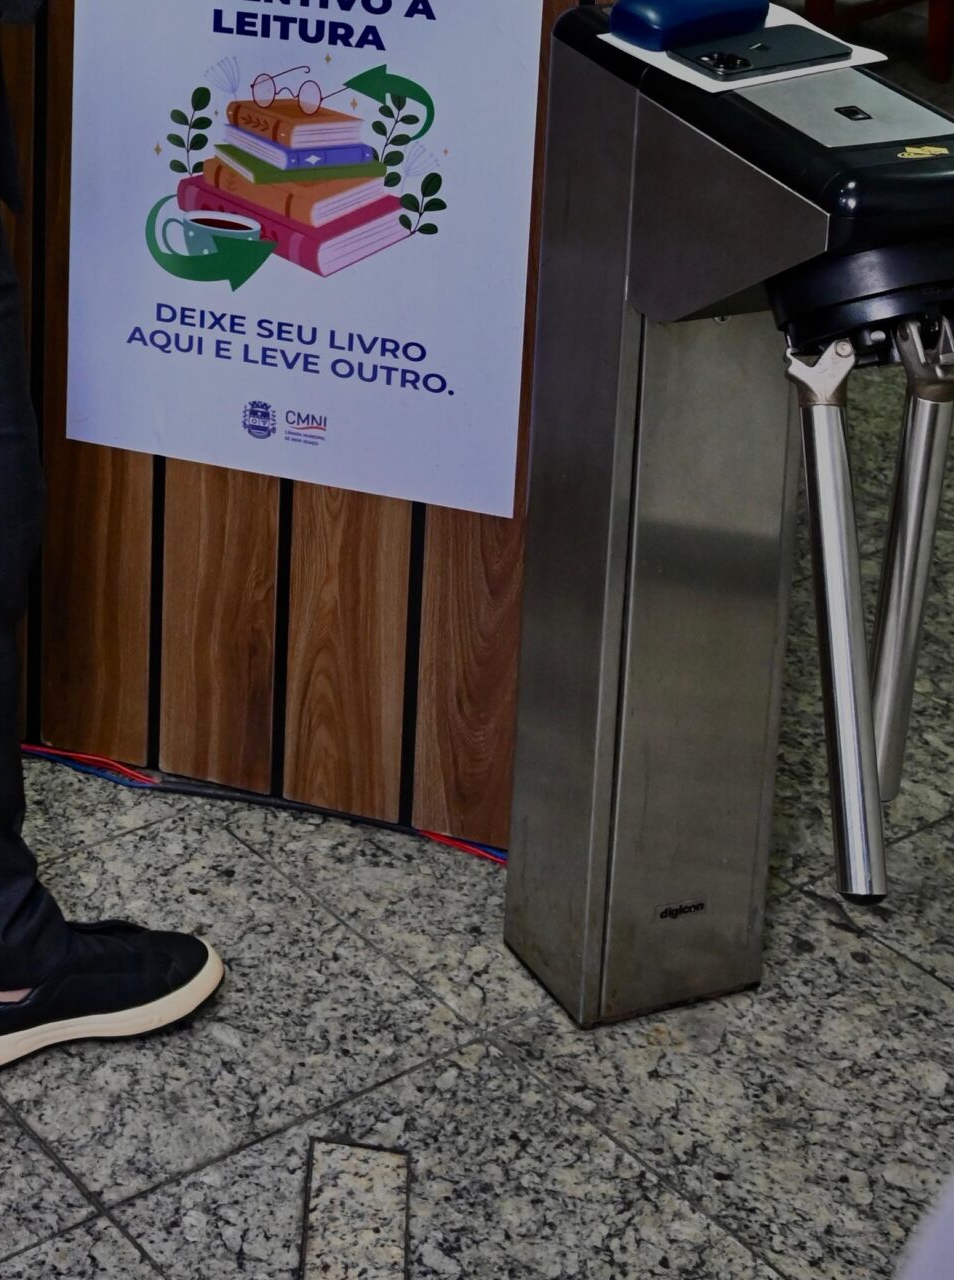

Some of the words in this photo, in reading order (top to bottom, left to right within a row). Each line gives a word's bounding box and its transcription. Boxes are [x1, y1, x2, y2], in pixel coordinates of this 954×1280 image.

[212, 9, 386, 51] LEITURA
[155, 302, 246, 335] DEIXE
[256, 319, 318, 346] SEU
[329, 330, 426, 362] LIVRO
[126, 326, 203, 355] AQUI
[215, 339, 232, 359] E
[243, 344, 320, 374] LEVE
[331, 358, 454, 396] OUTRO.
[285, 410, 327, 427] CMNI
[659, 902, 705, 919] digicon
